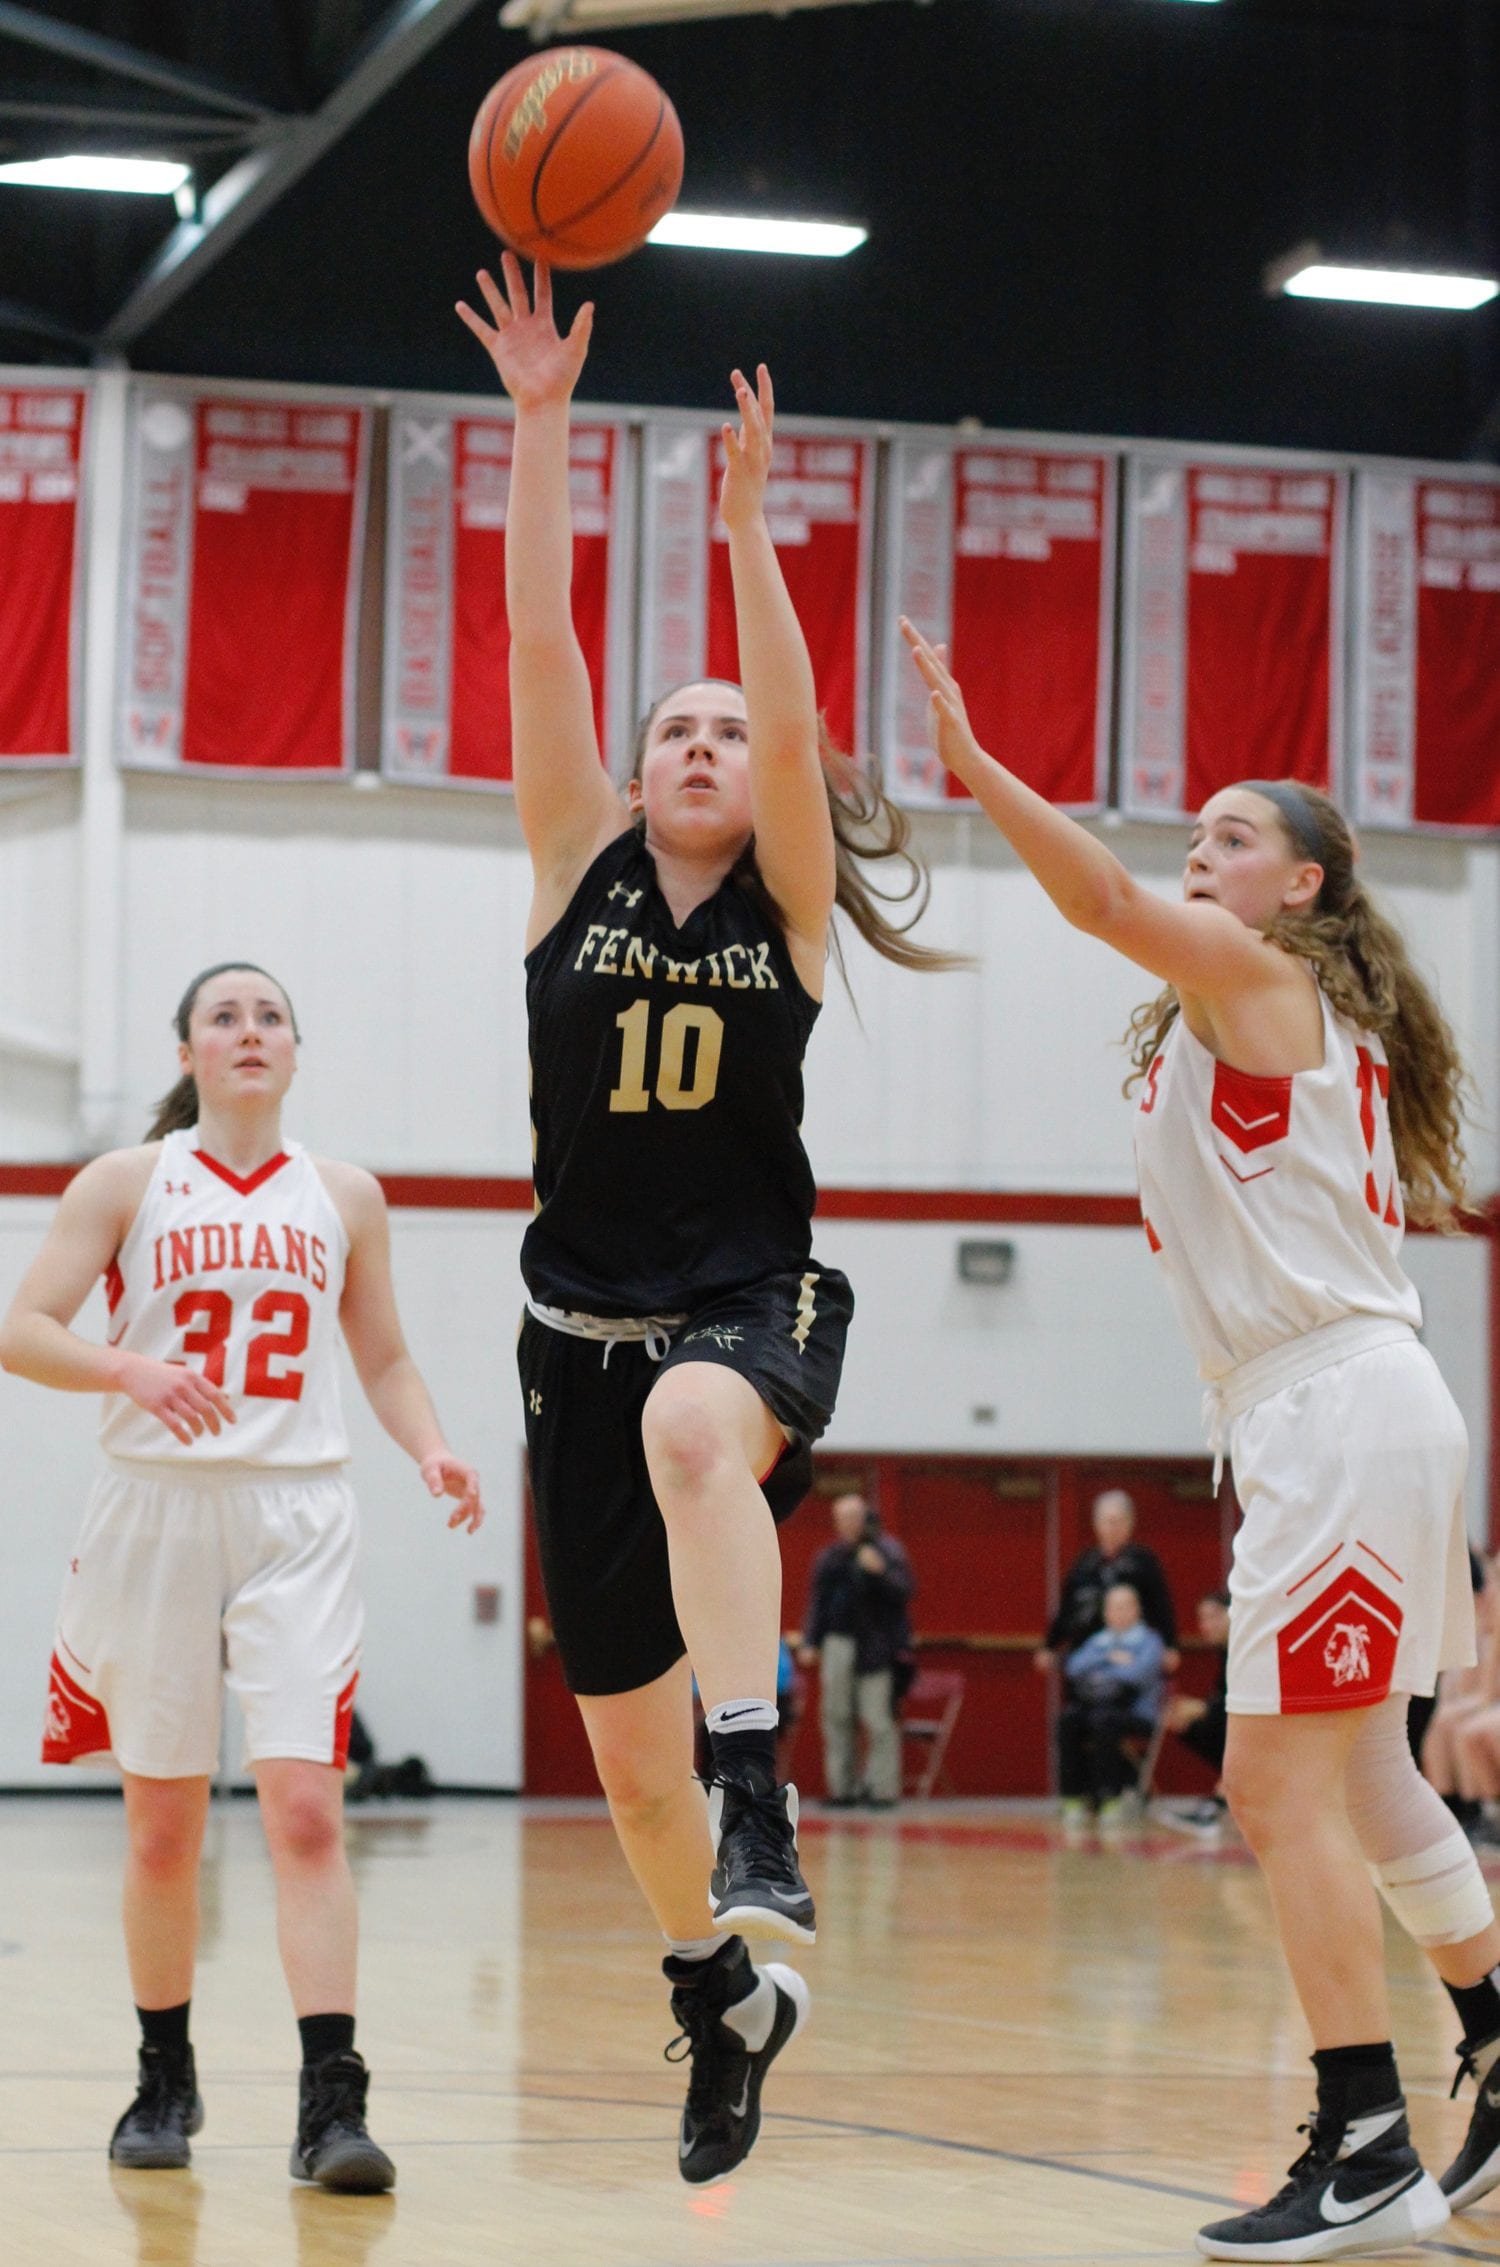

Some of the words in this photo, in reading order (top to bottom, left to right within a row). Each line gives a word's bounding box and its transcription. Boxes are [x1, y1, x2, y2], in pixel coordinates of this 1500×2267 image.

[573, 924, 780, 990] FENWICK
[608, 998, 725, 1113] 10
[153, 1221, 327, 1293] INDIANS
[165, 1289, 311, 1403] 32
